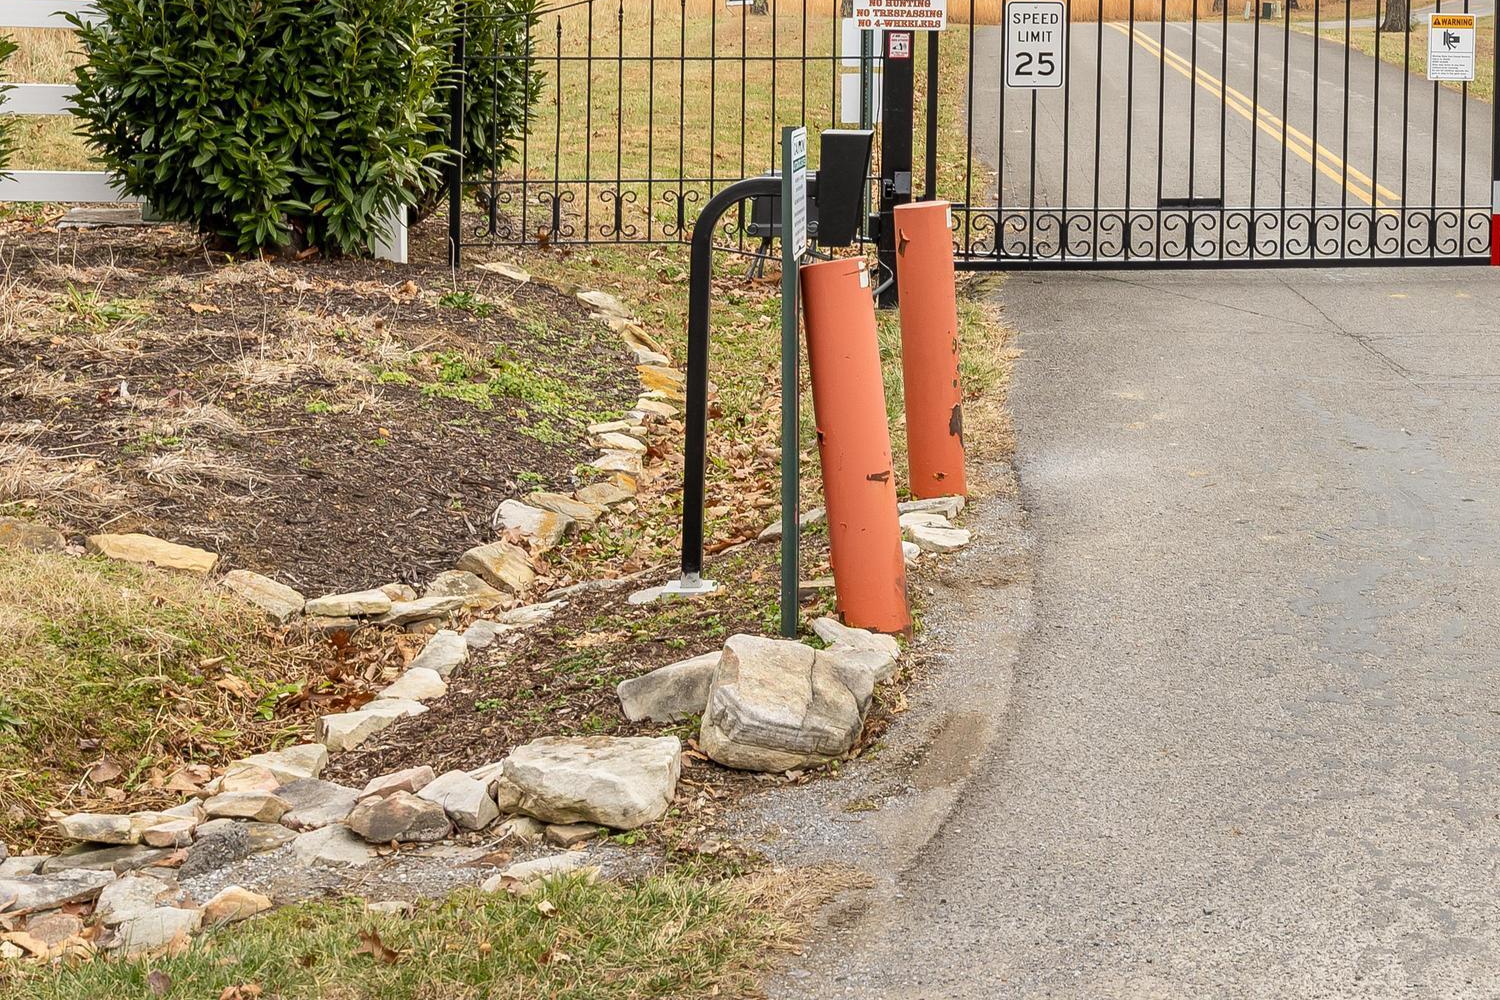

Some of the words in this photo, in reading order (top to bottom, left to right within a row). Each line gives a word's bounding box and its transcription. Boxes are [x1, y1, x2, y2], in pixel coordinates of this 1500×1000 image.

[885, 0, 931, 8] HUNTING
[856, 9, 870, 17] NO
[873, 9, 943, 18] TRESPASSING
[1012, 12, 1059, 25] SPEED
[1441, 18, 1473, 27] WARNING
[857, 19, 871, 27] NO
[874, 20, 941, 28] 4-WHEELERS
[1017, 30, 1053, 43] LIMIT
[1014, 51, 1055, 76] 25
